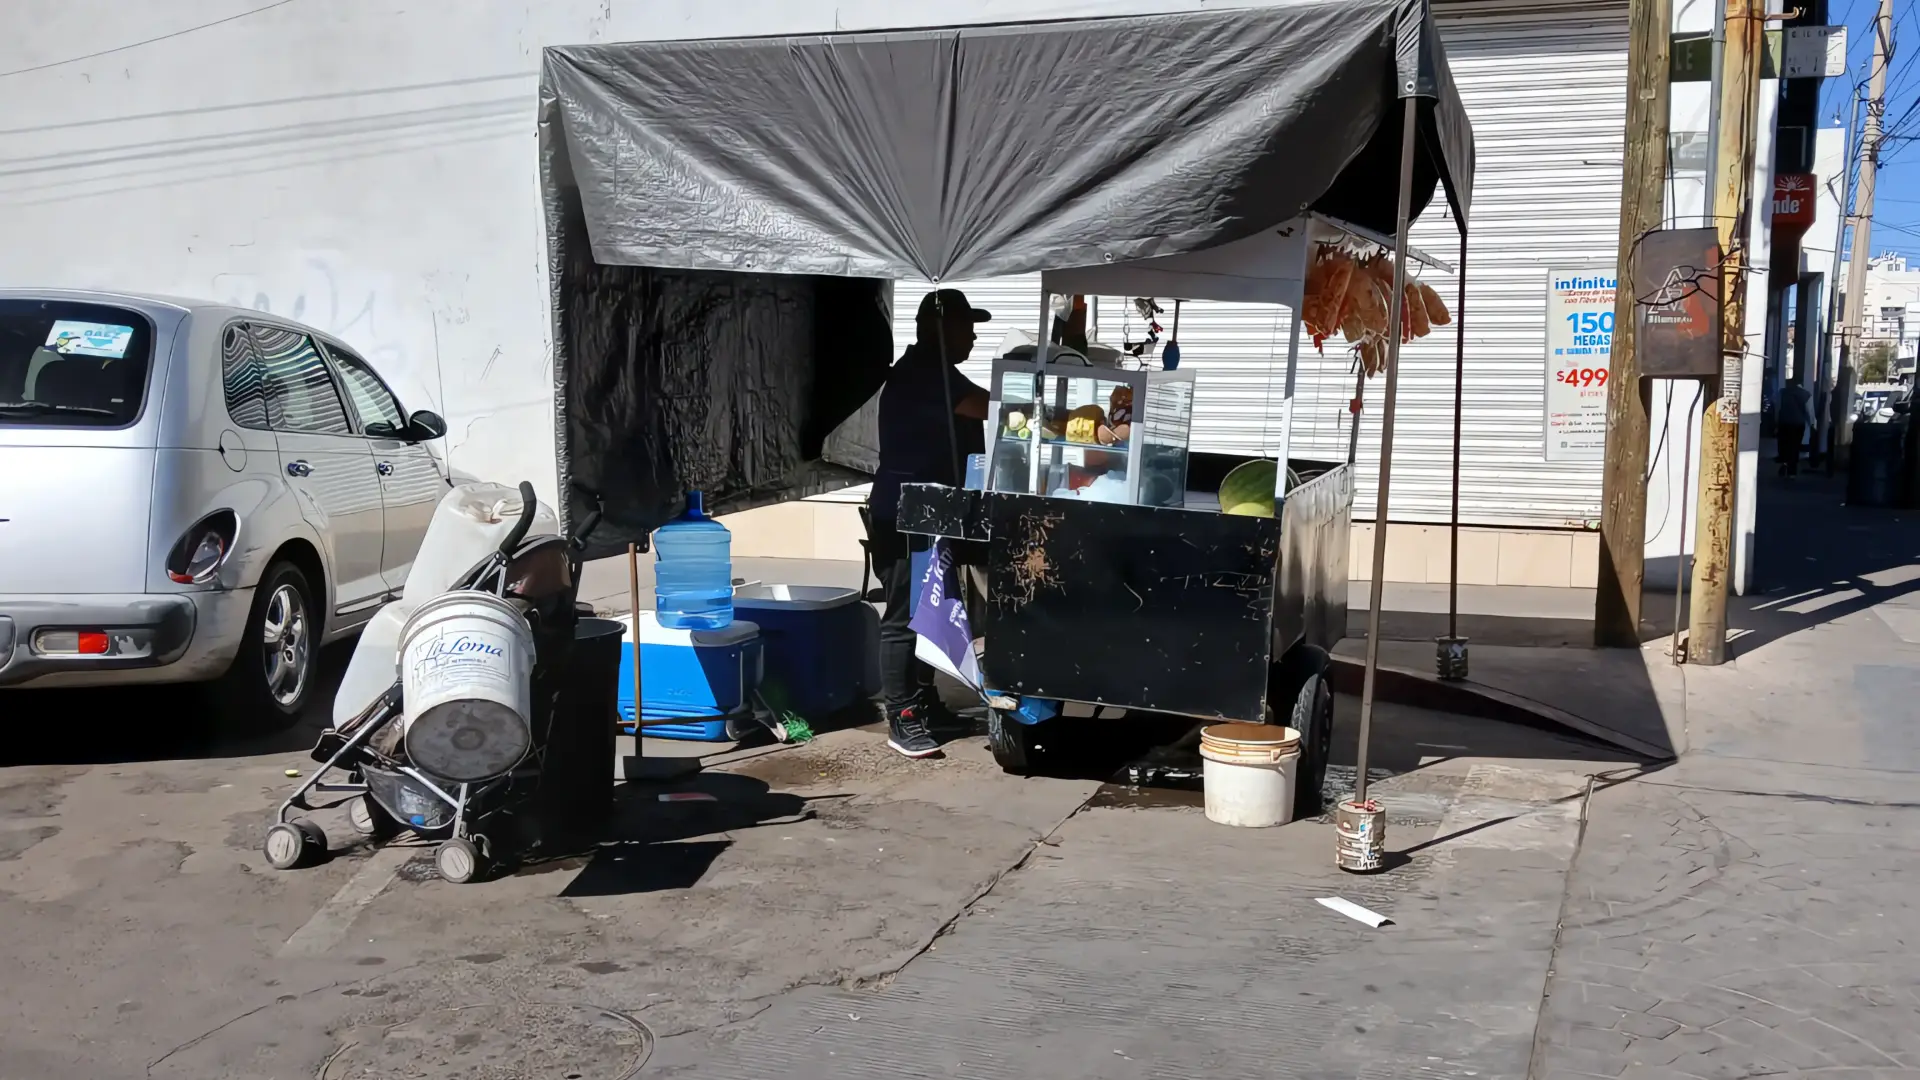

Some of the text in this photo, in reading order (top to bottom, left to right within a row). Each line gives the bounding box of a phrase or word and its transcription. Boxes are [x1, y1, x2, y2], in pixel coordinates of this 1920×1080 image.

[1771, 194, 1800, 214] nde
[1555, 276, 1617, 290] infinitu
[1566, 311, 1615, 334] 150
[1573, 334, 1611, 346] MEGAS
[1556, 368, 1609, 388] $499
[440, 636, 503, 658] Loma
